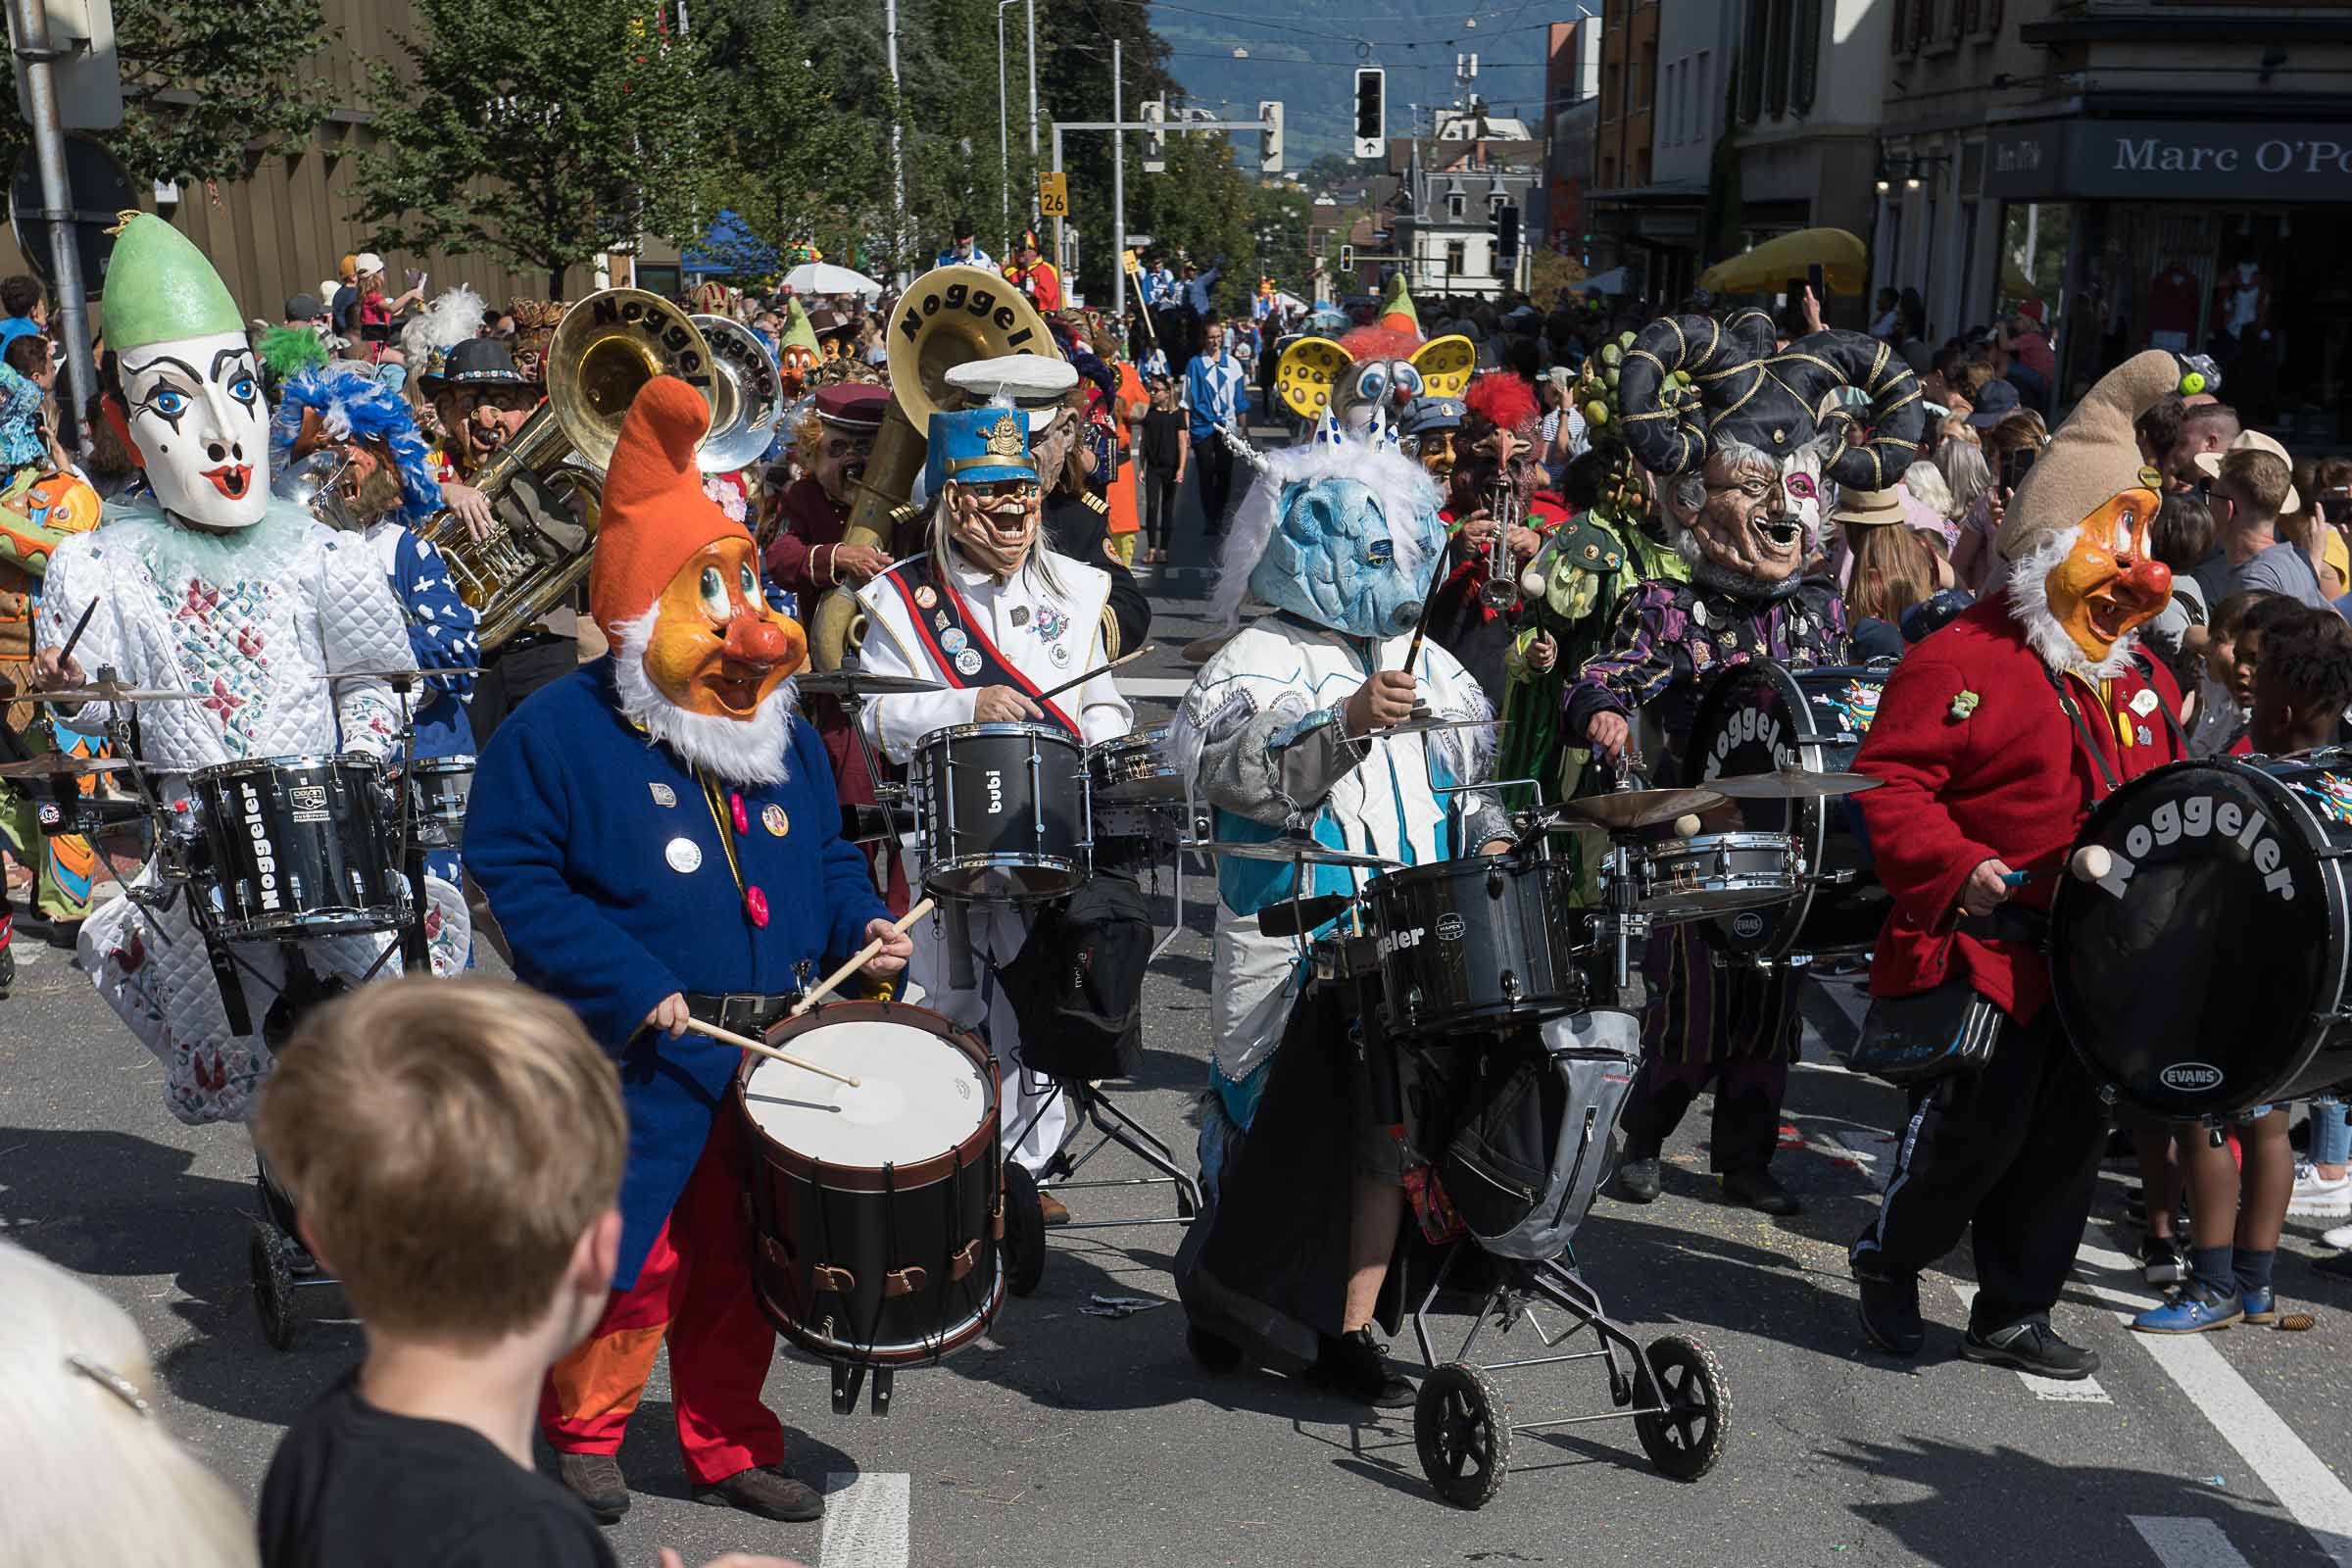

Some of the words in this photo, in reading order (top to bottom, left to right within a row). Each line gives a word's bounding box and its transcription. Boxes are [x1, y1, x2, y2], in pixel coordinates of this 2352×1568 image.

[2113, 139, 2238, 172] Marc
[1045, 195, 1063, 211] 26
[900, 284, 1035, 355] Noggel
[986, 770, 1003, 814] bubi
[241, 783, 280, 909] Noggeler
[2095, 796, 2295, 901] Noggeler
[1440, 923, 1461, 932] MAPEX
[2167, 1070, 2215, 1083] EVANS
